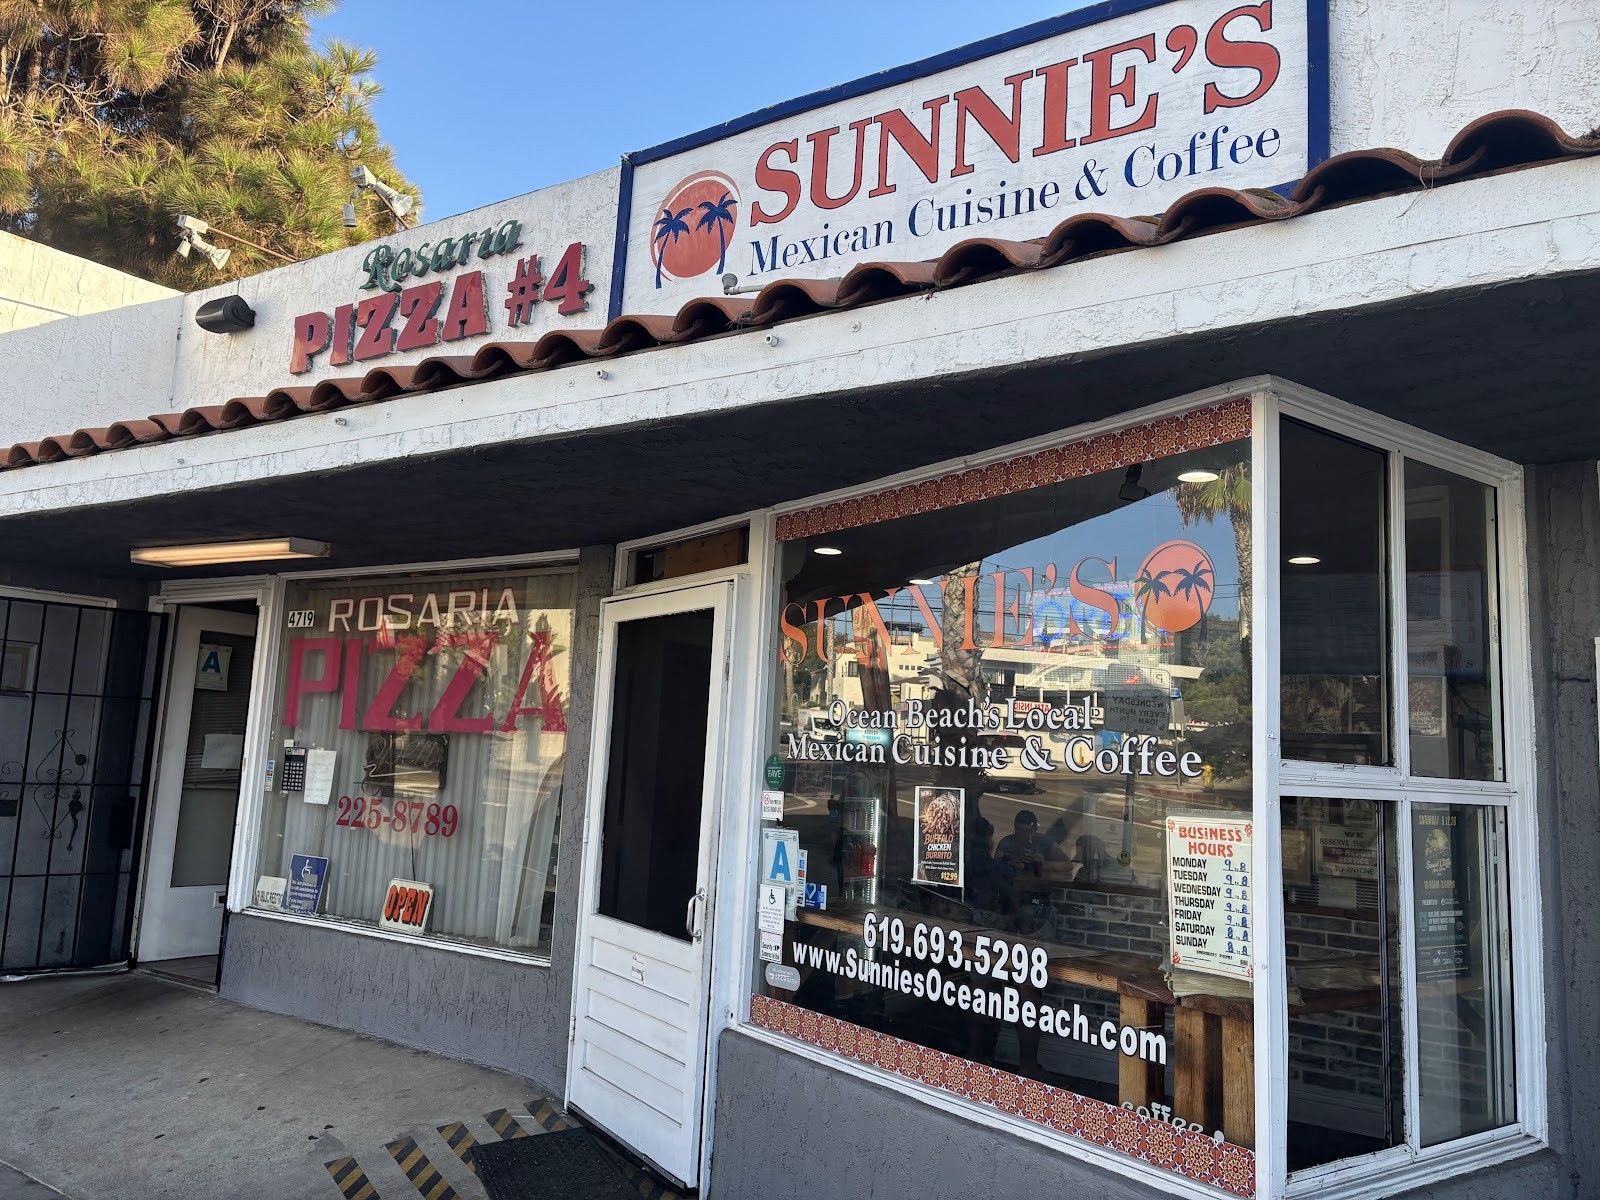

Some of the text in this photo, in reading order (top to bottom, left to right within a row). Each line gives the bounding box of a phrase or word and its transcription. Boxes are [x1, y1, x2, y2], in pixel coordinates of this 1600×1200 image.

[750, 0, 1281, 228] SUNNIE'S
[747, 125, 1281, 278] Mexican Cuisine & Coffee
[359, 219, 524, 292] Rosaria
[290, 241, 595, 374] PIZZA #4
[328, 587, 520, 633] ROSARIA
[779, 555, 1118, 666] SUNNIE'S
[289, 611, 314, 627] 4719
[201, 651, 221, 673] A
[282, 631, 568, 735] PIZZA
[828, 695, 1093, 731] Ocean Beach's Local
[787, 733, 1202, 777] Mexican Cuisine & Coffee
[768, 770, 782, 778] FAVE
[336, 795, 459, 838] 225-8789
[925, 834, 953, 844] BUFFALO
[928, 843, 952, 851] CHICKEN
[1320, 838, 1350, 847] RESERVE
[926, 852, 952, 860] BURRITO
[1188, 842, 1233, 858] HOURS
[770, 841, 791, 881] A
[1173, 857, 1207, 869] MONDAY
[1224, 859, 1232, 871] 9
[1338, 857, 1370, 865] SERVICE
[1173, 870, 1208, 882] TUESDAY
[1226, 874, 1233, 885] 9
[1335, 865, 1375, 875] TO ANYONE
[1173, 883, 1221, 897] WEDNESDAY
[1226, 888, 1232, 898] 9
[383, 885, 430, 927] OPEN
[1174, 896, 1215, 909] THURSDAY
[1226, 902, 1232, 911] 9
[1174, 909, 1202, 921] FRIDAY
[1227, 915, 1232, 924] 9
[1175, 922, 1215, 936] SATURDAY
[1175, 935, 1207, 948] SUNDAY
[863, 911, 1049, 990] 619.693.5298
[791, 941, 1168, 1066] www.SunniesOceanBeach.com
